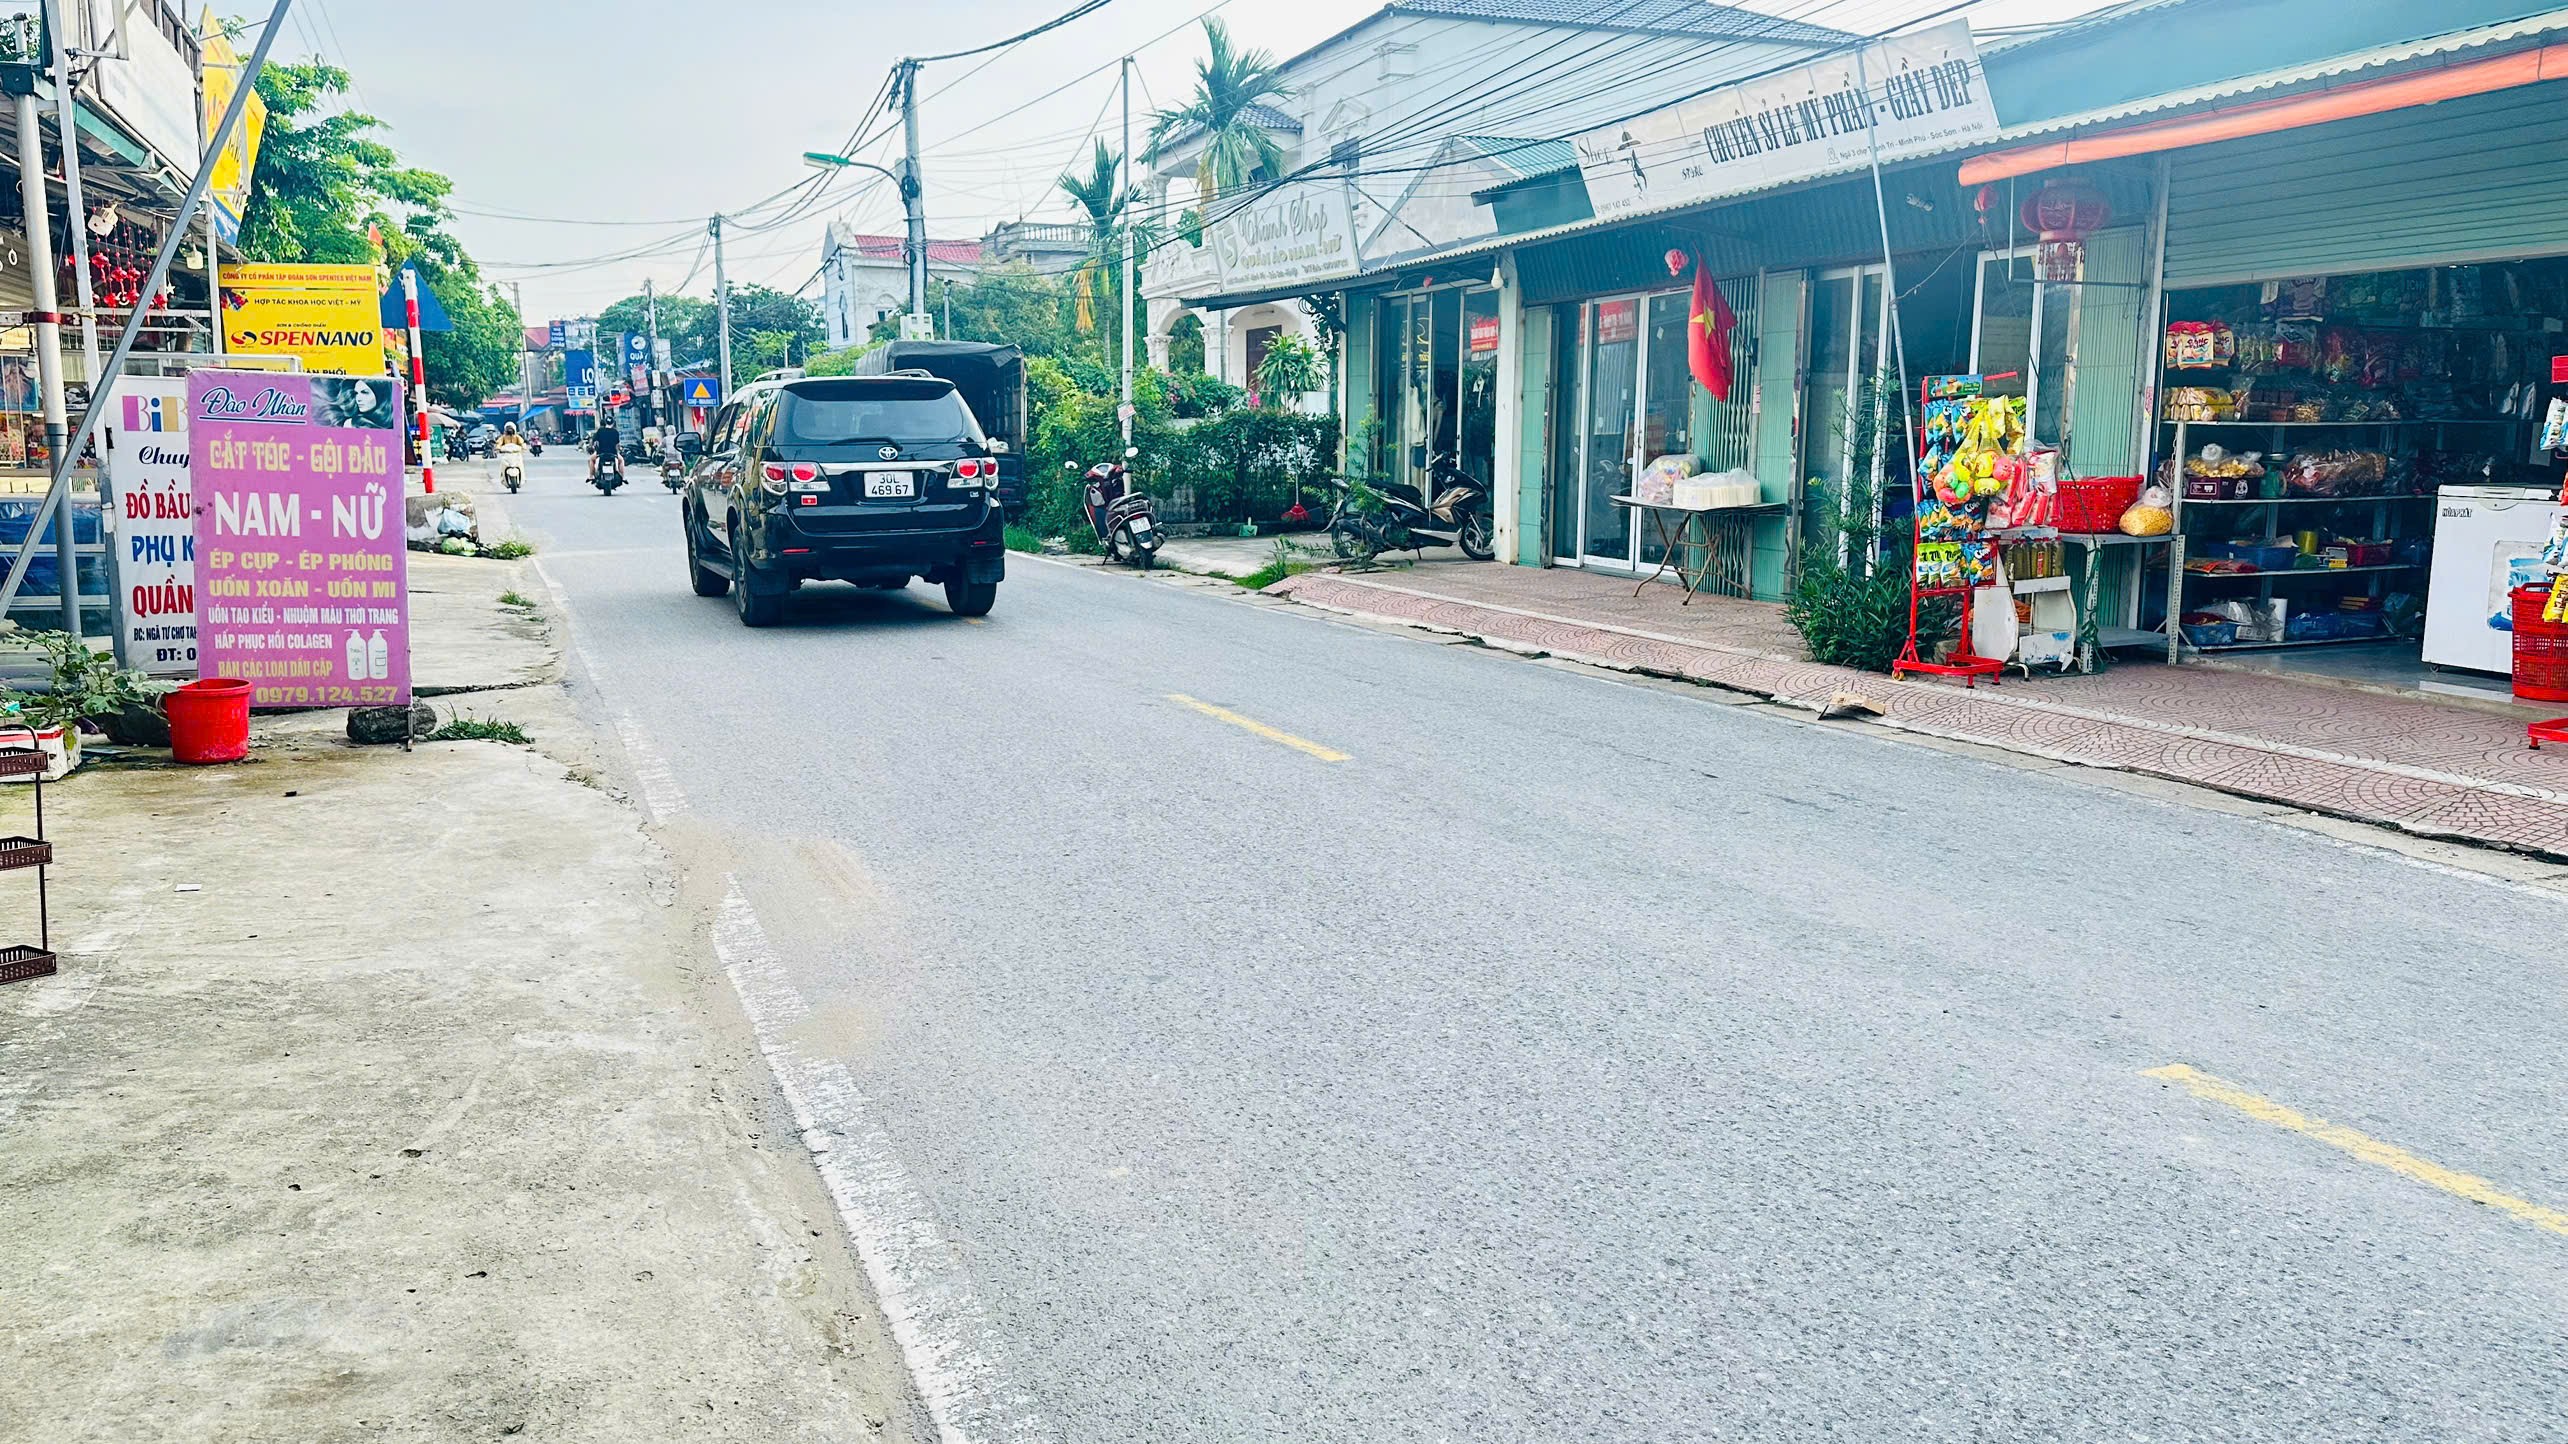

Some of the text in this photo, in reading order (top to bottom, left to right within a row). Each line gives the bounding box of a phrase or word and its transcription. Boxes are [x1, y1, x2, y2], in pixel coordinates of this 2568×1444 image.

[1703, 109, 1762, 164] CHUYÊN
[1758, 98, 1781, 151] SỈ
[1774, 93, 1802, 147] LẺ
[1796, 90, 1826, 142] MỸ
[1886, 57, 1934, 121] GIẦY
[1930, 50, 1973, 111] DÉP
[1290, 190, 1328, 246] Shop
[260, 331, 374, 346] SPENNANO
[202, 387, 246, 414] Đào
[210, 430, 247, 470] CẮT
[252, 436, 290, 471] TÓC
[311, 438, 343, 479] GỘI
[348, 434, 387, 475] ĐẦU
[880, 474, 900, 484] 30L
[126, 478, 190, 519] ĐỒ BẦU
[214, 492, 300, 537] NAM
[332, 482, 387, 540] NỮ
[132, 535, 175, 568] PHỤ
[209, 548, 234, 569] ÉP
[241, 552, 280, 573] CỤP
[299, 549, 323, 570] ÉP
[132, 574, 194, 618] QUẦN
[209, 574, 250, 597] UỐN
[256, 577, 309, 597] XOĂN
[328, 575, 366, 598] UỐN
[372, 581, 396, 598] MI
[208, 602, 229, 624] UỐN
[231, 608, 250, 627] TẠO
[252, 600, 274, 624] KIỂU
[283, 604, 318, 628] NHUỘM
[321, 603, 342, 624] MÀU
[344, 604, 366, 624] THỜI
[368, 608, 399, 624] TRANG
[214, 628, 235, 649] HẤP
[238, 634, 265, 652] PHỤC
[288, 633, 332, 649] COLAGEN
[157, 648, 182, 661] ĐT:
[265, 661, 288, 681] LOẠI
[256, 686, 398, 703] 0979.124.527
